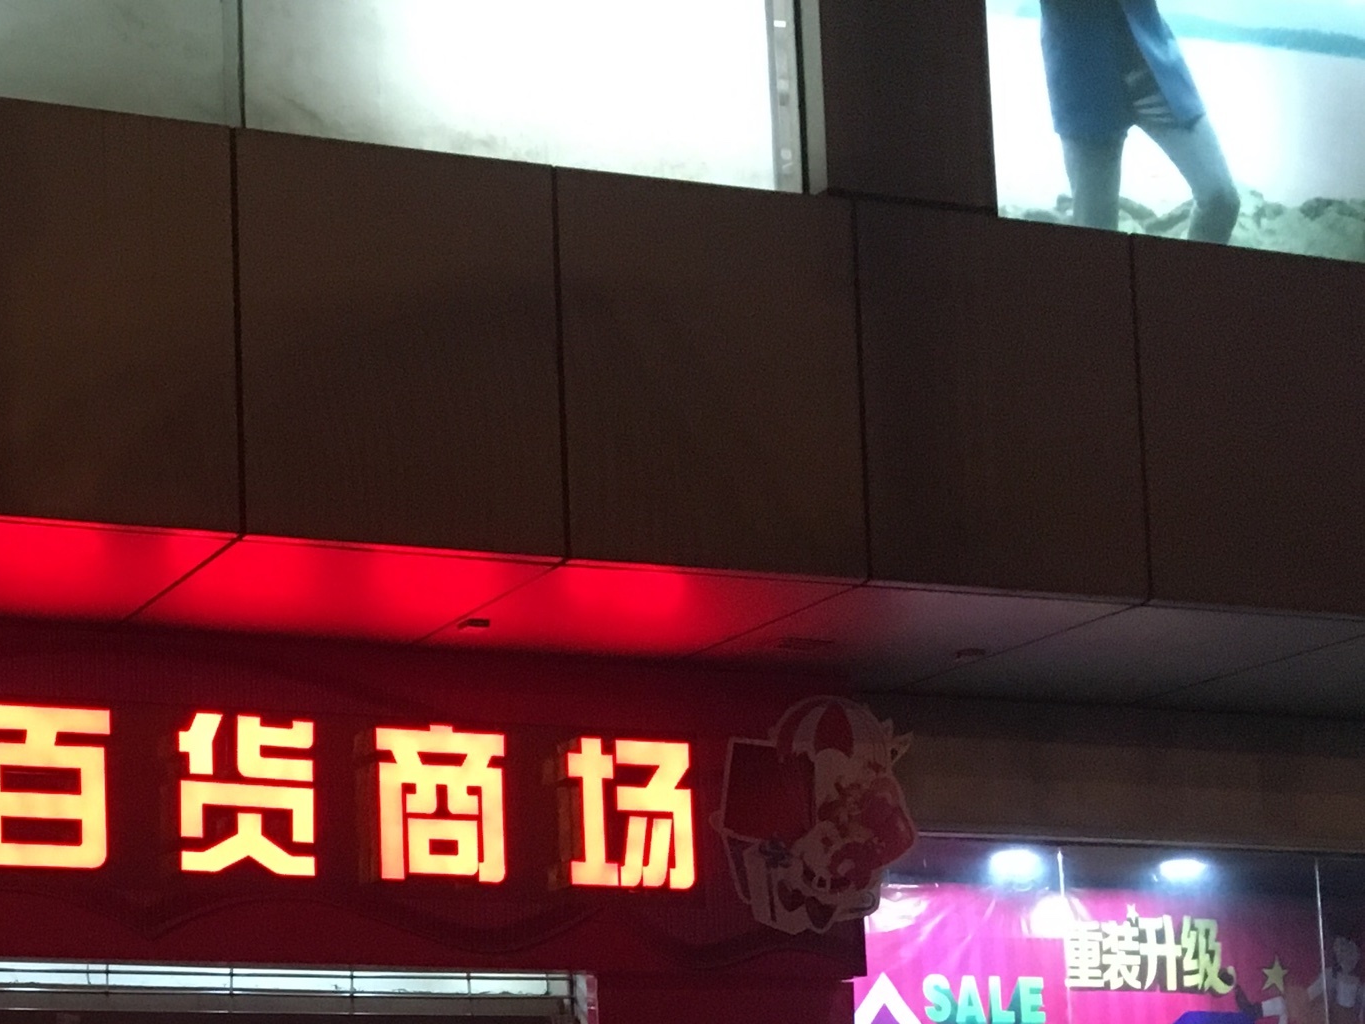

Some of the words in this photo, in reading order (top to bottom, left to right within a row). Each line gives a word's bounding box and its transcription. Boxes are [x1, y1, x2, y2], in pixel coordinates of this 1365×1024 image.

[1065, 914, 1235, 994] 重装升级
[923, 975, 1047, 1024] SALE
